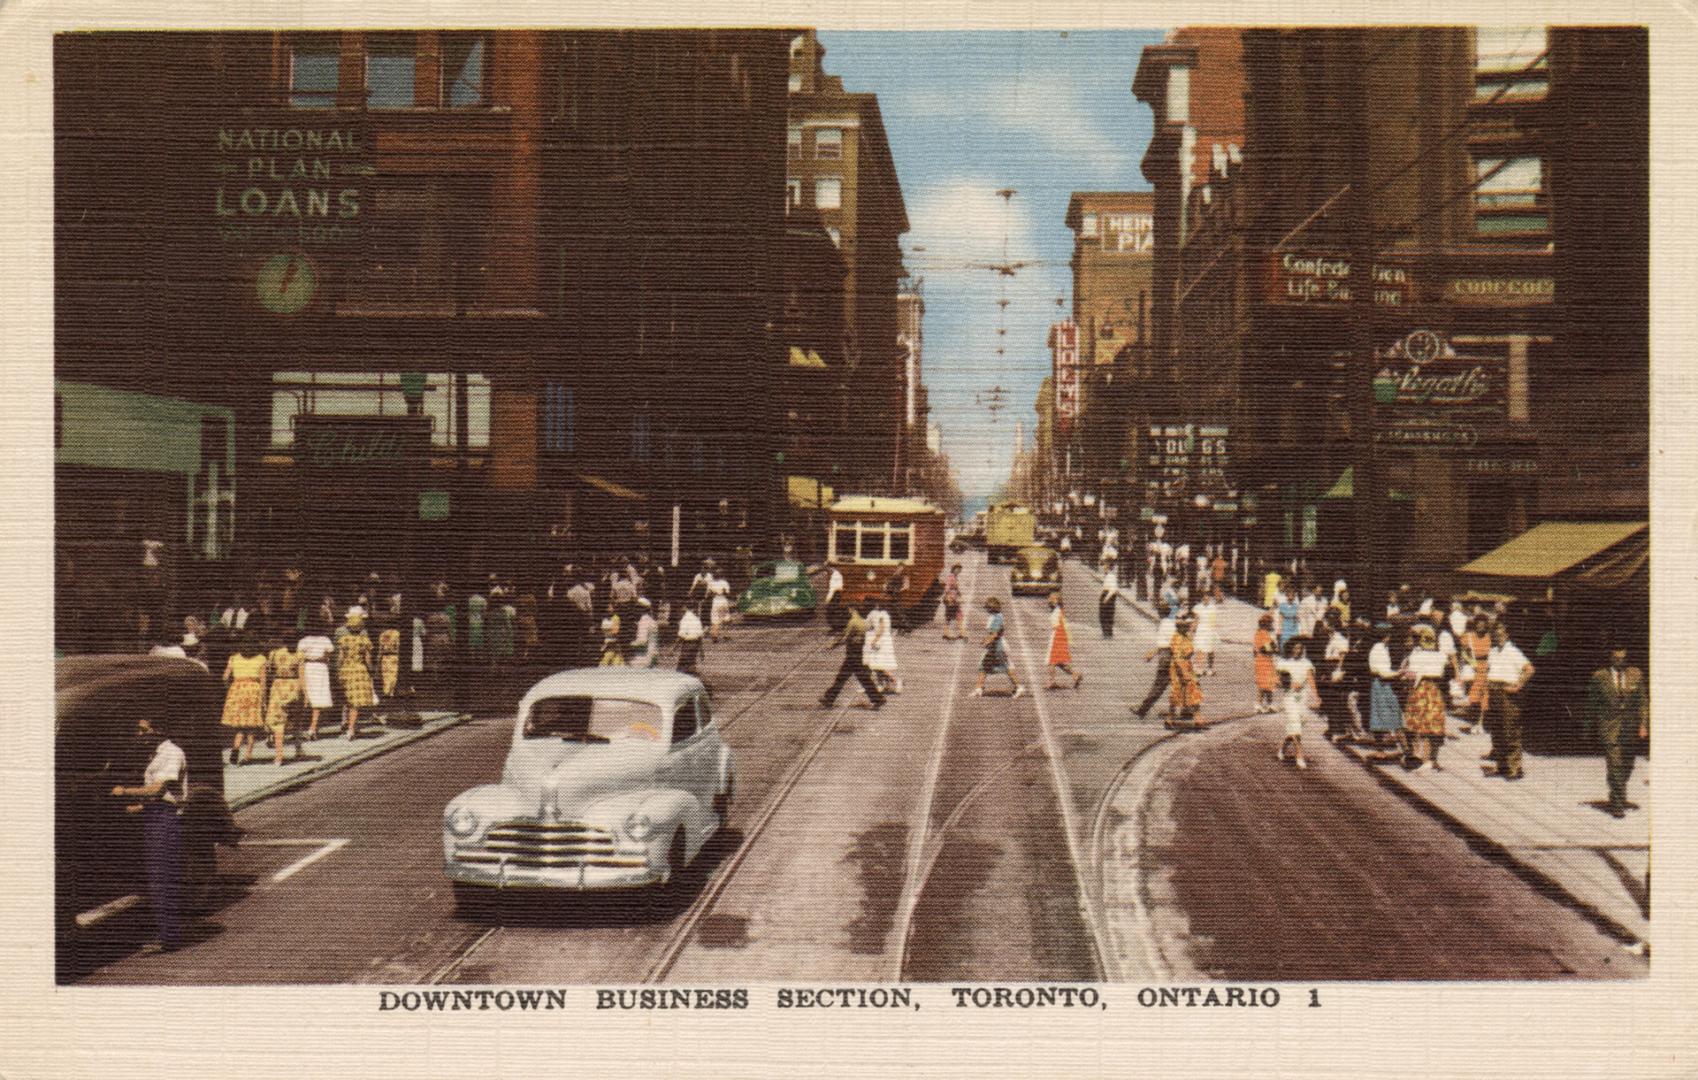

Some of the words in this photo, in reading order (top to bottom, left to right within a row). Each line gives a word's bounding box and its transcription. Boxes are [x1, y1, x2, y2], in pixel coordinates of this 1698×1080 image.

[217, 128, 361, 151] NATIONAL
[248, 157, 331, 180] PLAN
[215, 187, 361, 218] LOANS
[1287, 278, 1320, 302] Life
